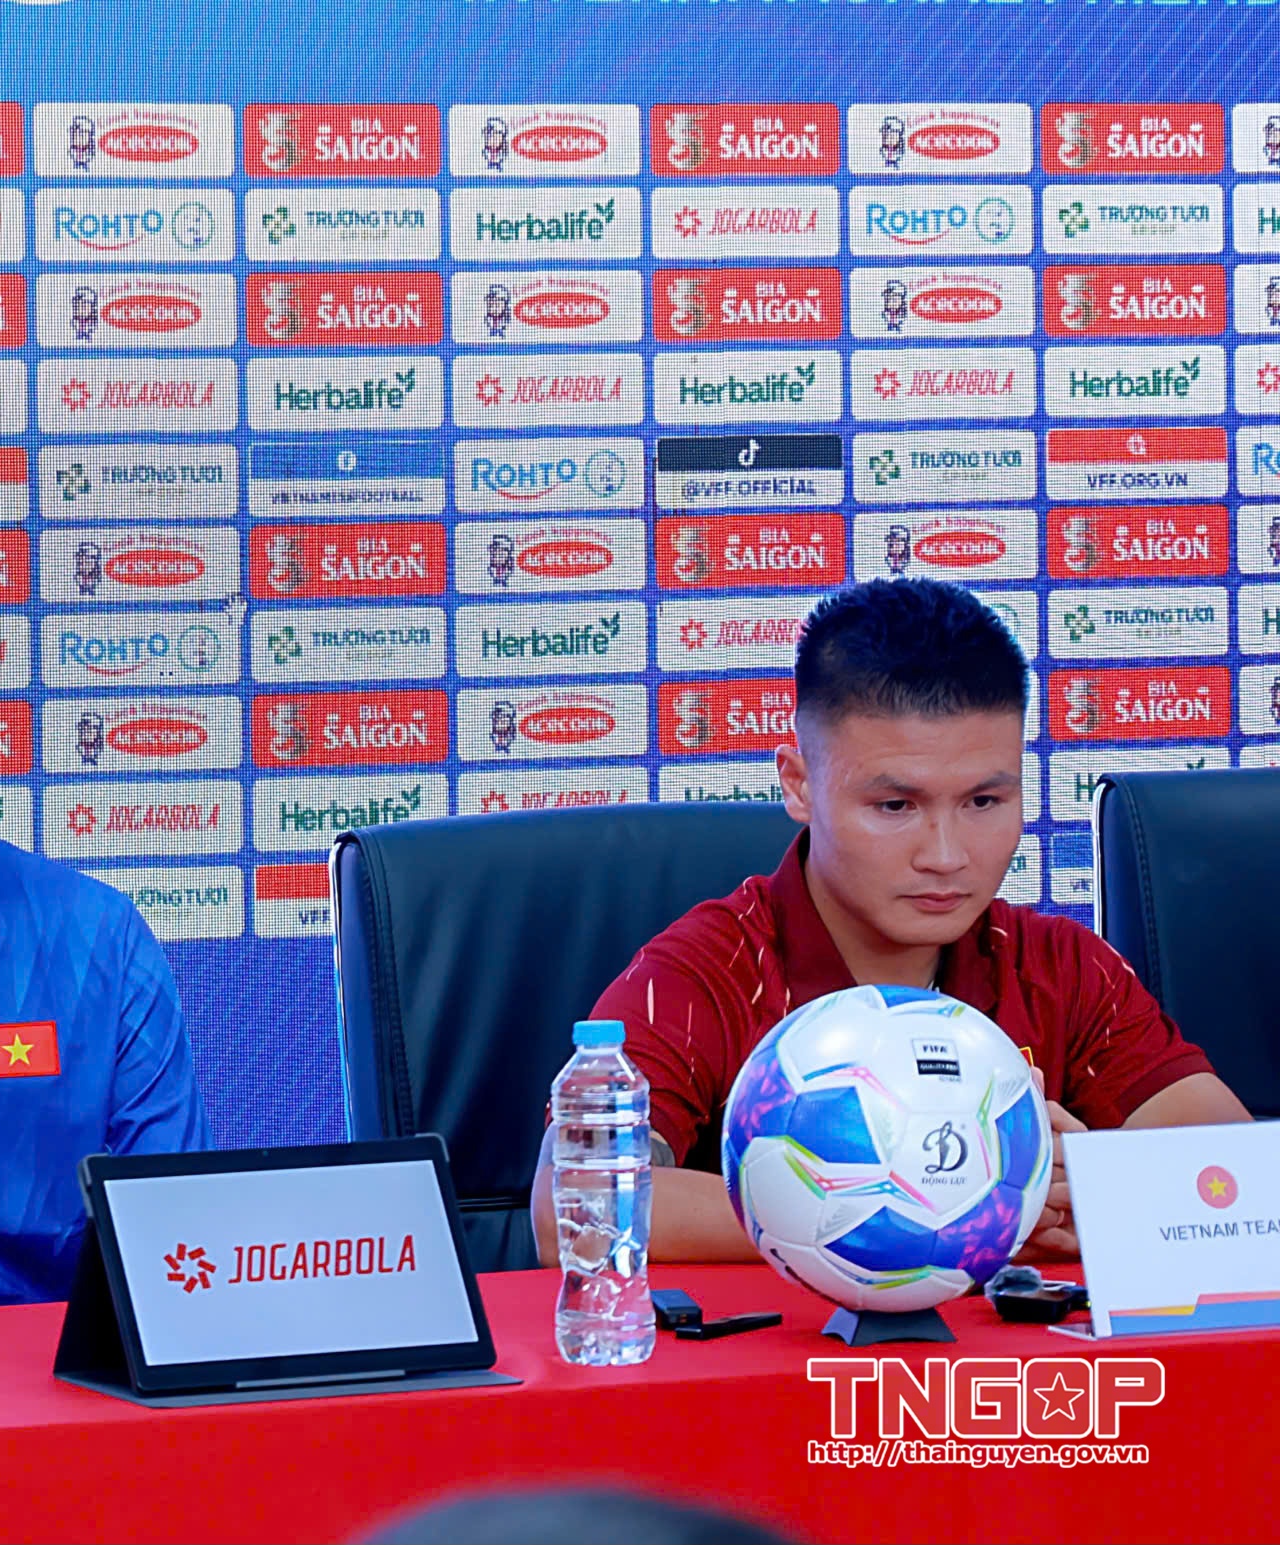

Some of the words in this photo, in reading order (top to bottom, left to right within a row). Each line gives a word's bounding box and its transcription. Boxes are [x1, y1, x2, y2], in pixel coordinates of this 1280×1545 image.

[351, 117, 383, 133] BIA
[754, 117, 784, 133] BIA
[1141, 116, 1171, 132] BIA
[315, 134, 420, 161] SAIGON
[719, 134, 821, 160] SAIGON
[1107, 132, 1206, 158] SAIGON
[53, 207, 164, 241] ROHTO
[477, 210, 604, 241] Herbalife
[866, 203, 968, 236] ROHTO
[353, 286, 385, 302] BIA
[756, 282, 787, 298] BIA
[1143, 278, 1173, 294] BIA
[317, 302, 422, 329] SAIGON
[721, 298, 823, 325] SAIGON
[1109, 294, 1207, 320] SAIGON
[274, 379, 404, 411] Herbalife
[680, 373, 805, 405] Herbalife
[1069, 367, 1190, 398] Herbalife
[472, 455, 578, 489] ROHTO
[759, 529, 790, 545] BIA
[1146, 519, 1175, 535] BIA
[357, 538, 388, 554] BIA
[725, 544, 825, 572] SAIGON
[1112, 535, 1210, 562] SAIGON
[321, 554, 426, 581] SAIGON
[60, 631, 169, 667] ROHTO
[483, 624, 609, 658] Herbalife
[761, 692, 792, 709] BIA
[1148, 679, 1178, 696] BIA
[359, 705, 390, 721] BIA
[1115, 695, 1212, 723] SAIGON
[323, 720, 427, 749] SAIGON
[727, 709, 796, 737] SAIG
[1159, 1222, 1239, 1241] VIETNAM
[1242, 1218, 1280, 1236] TEA
[227, 1234, 416, 1284] JOGARBOLA
